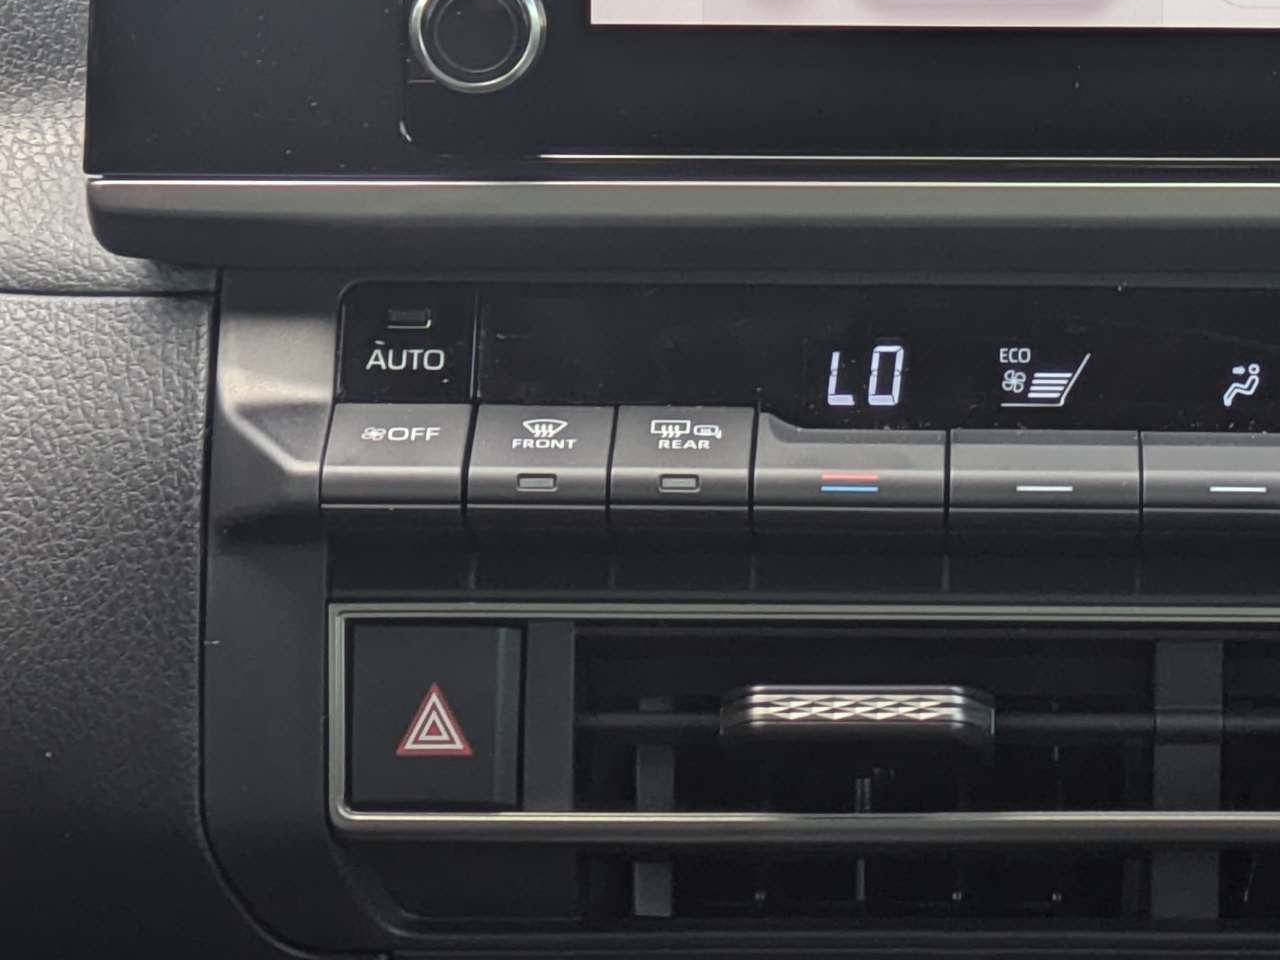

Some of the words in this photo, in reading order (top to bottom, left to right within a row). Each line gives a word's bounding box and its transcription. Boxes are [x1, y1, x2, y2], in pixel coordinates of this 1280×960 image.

[365, 348, 446, 372] AUTO
[999, 348, 1031, 364] ECO
[387, 426, 441, 443] OFF
[511, 437, 577, 451] FRONT
[657, 437, 711, 451] REAR
